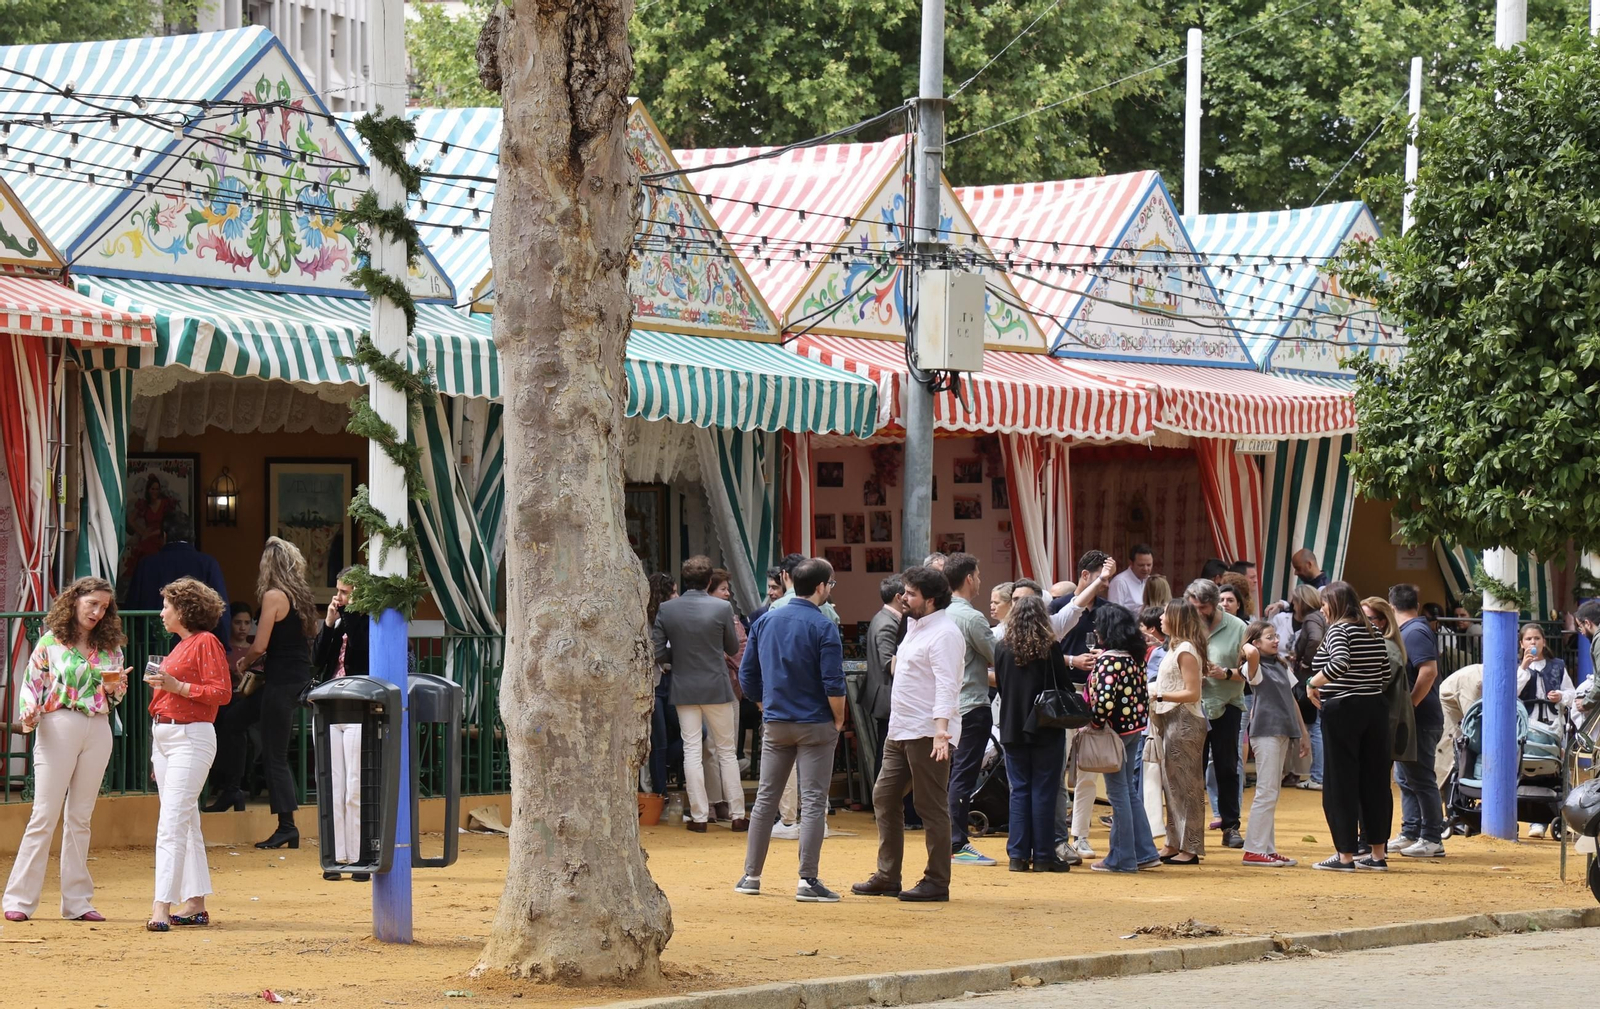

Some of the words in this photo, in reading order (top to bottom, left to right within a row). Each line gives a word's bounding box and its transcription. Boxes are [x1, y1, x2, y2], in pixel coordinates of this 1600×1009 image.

[430, 275, 441, 294] 16
[1141, 317, 1149, 326] LA
[1149, 317, 1175, 328] CARROZA
[1236, 440, 1245, 451] LA
[1248, 440, 1275, 451] CARROZA
